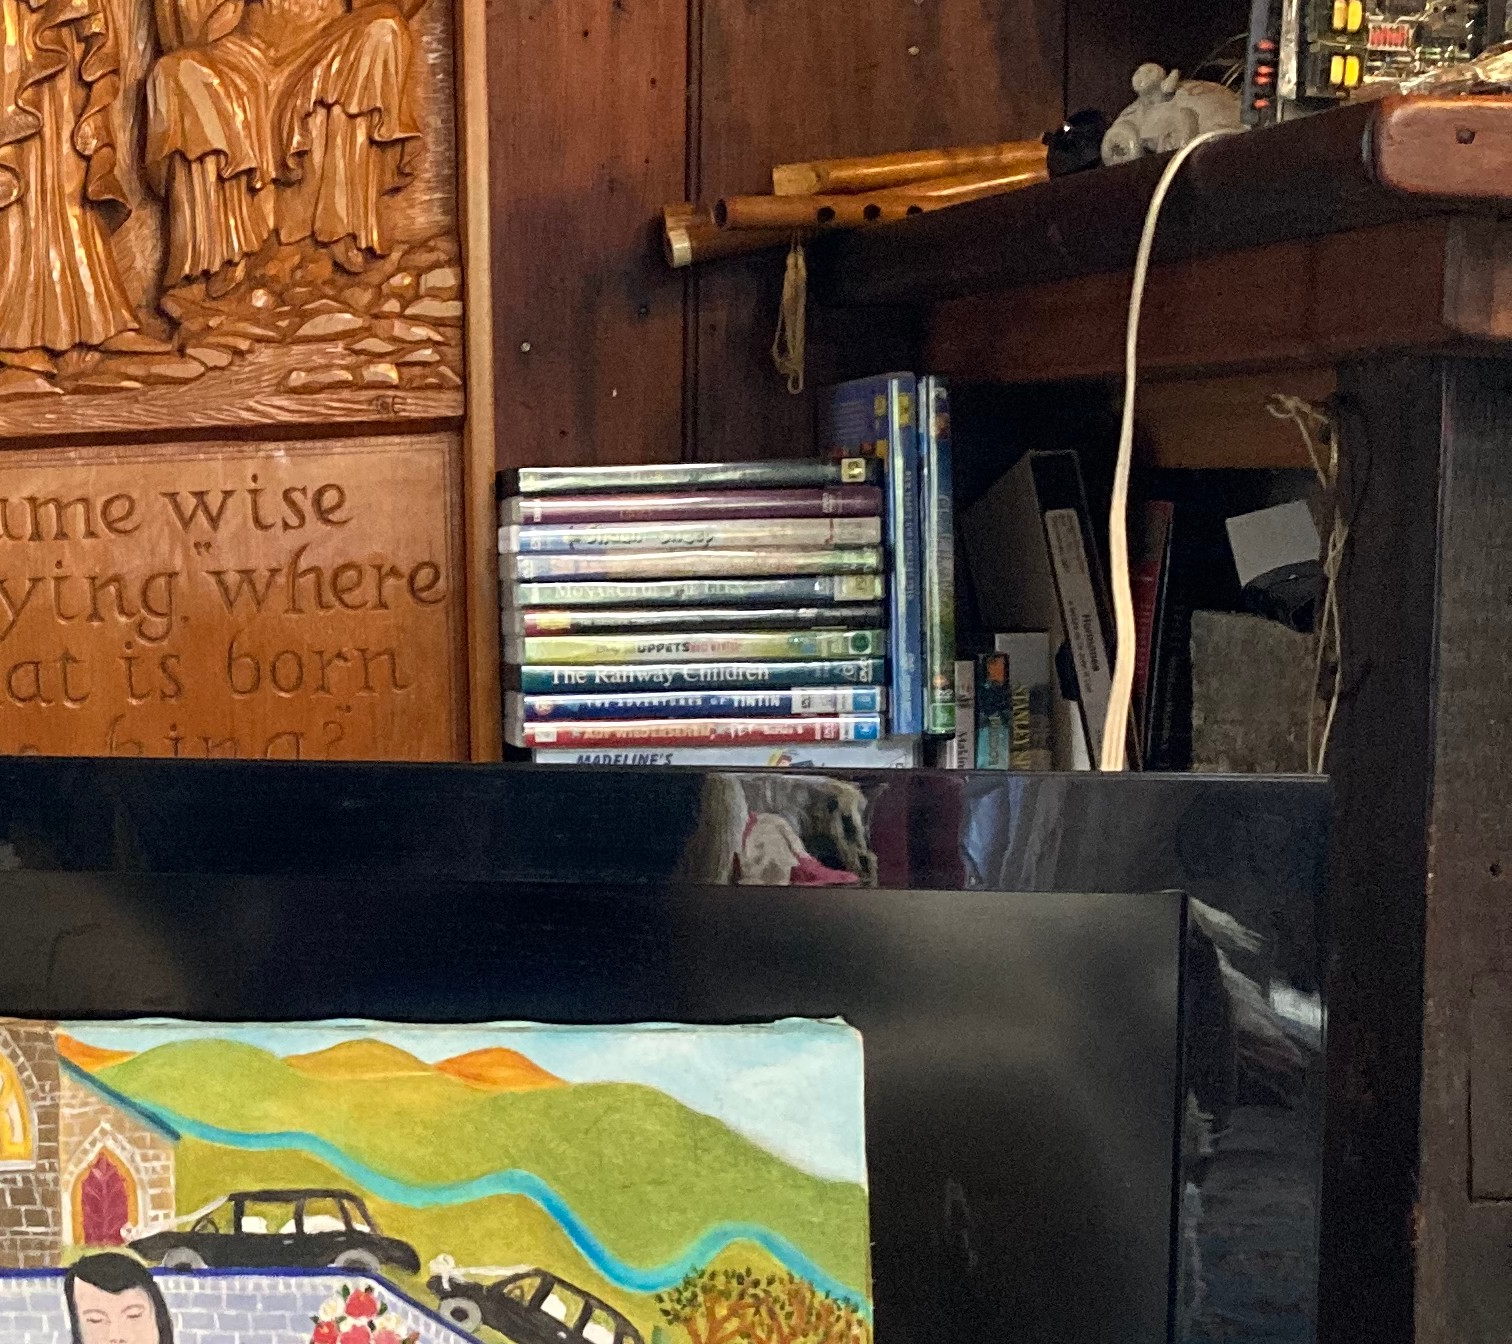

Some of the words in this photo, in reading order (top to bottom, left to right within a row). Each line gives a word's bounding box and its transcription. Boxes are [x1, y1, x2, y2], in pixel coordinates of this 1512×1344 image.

[161, 473, 354, 534] wise
[121, 640, 186, 702] is
[226, 628, 410, 699] born
[551, 667, 586, 685] The
[594, 667, 676, 686] Railway
[683, 664, 770, 683] Children
